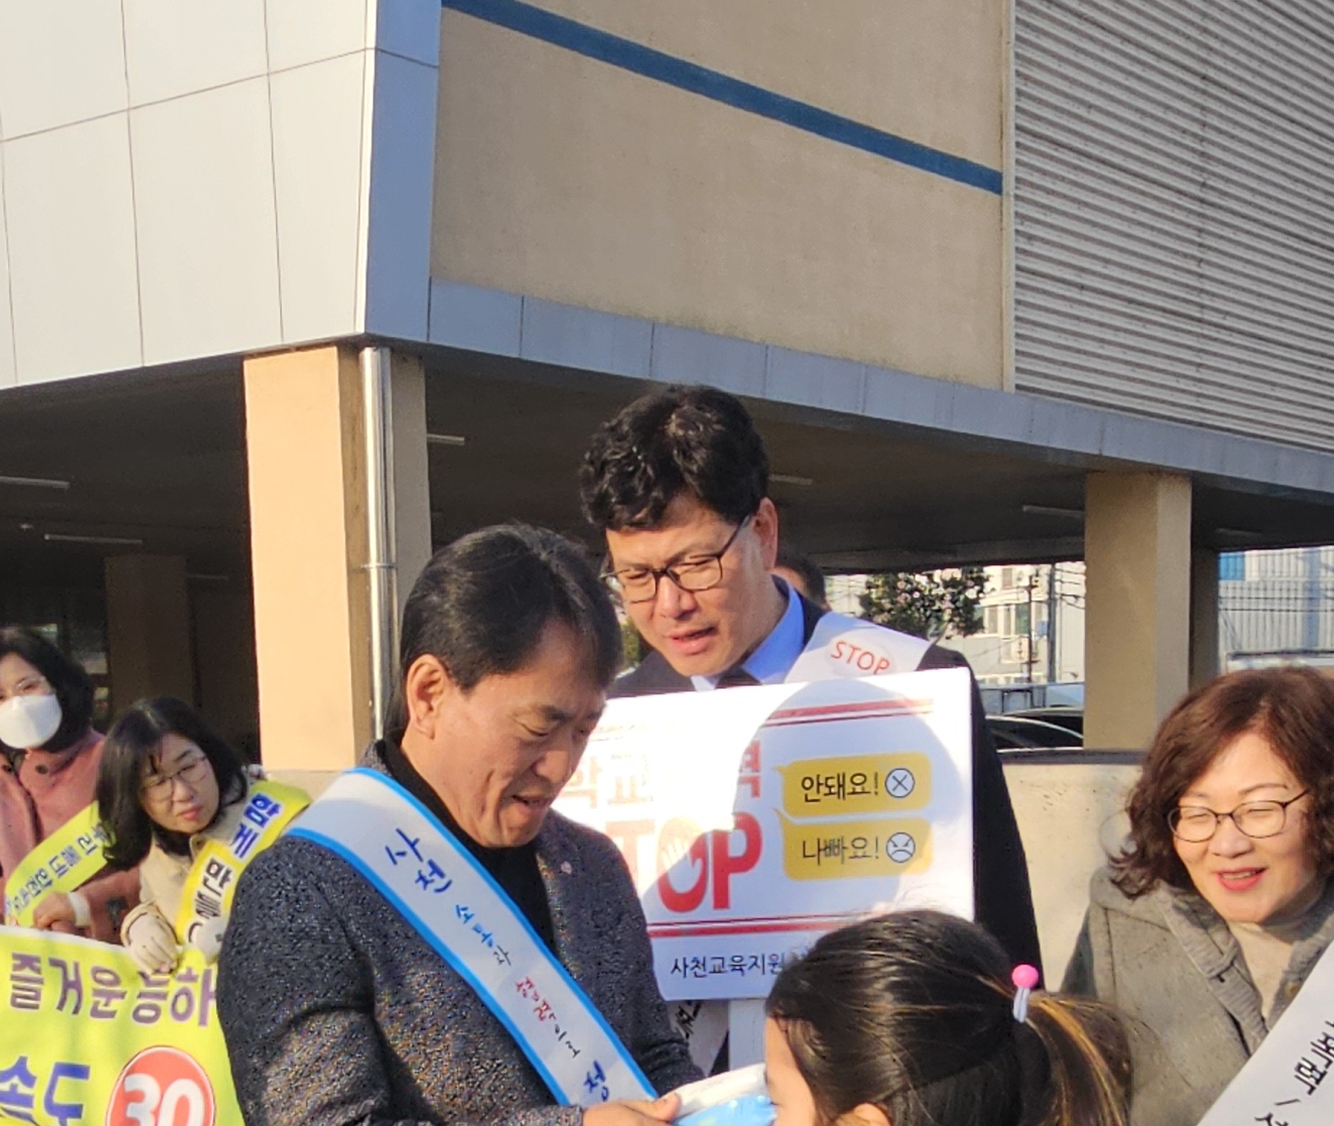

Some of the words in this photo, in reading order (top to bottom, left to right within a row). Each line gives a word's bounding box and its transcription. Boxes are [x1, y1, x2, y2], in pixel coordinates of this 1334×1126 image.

[830, 641, 891, 675] STOP
[801, 772, 879, 803] 안돼요!
[384, 827, 453, 893] 사천
[605, 812, 763, 914] TOP
[802, 837, 880, 866] 나빠요!
[9, 952, 132, 1021] 즐거운
